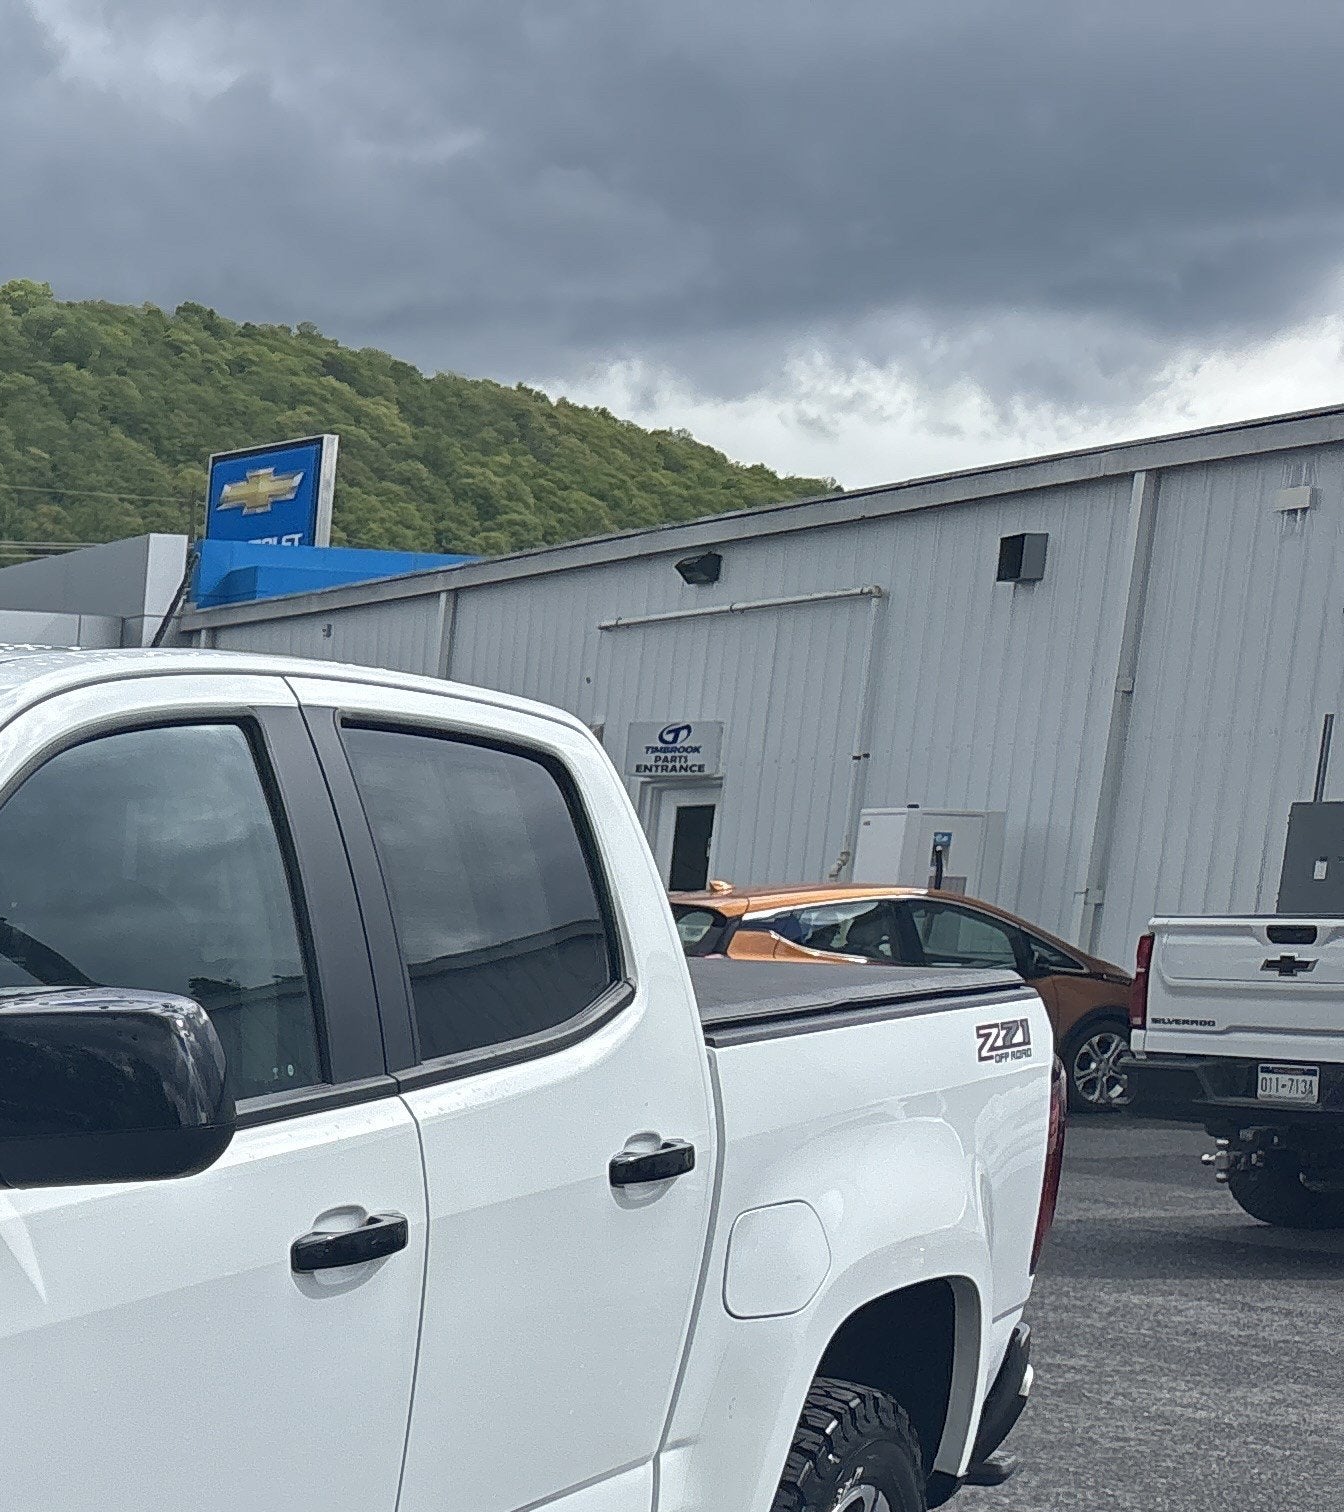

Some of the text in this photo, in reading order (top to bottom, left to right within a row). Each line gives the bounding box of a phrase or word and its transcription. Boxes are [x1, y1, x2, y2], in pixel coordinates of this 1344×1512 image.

[645, 745, 702, 755] TIMBROOK
[654, 755, 689, 764] PARTS
[635, 764, 705, 773] ENTRANCE
[1151, 1017, 1216, 1027] SILVERADO
[975, 1017, 1031, 1063] Z71
[1010, 1047, 1033, 1061] ROAD
